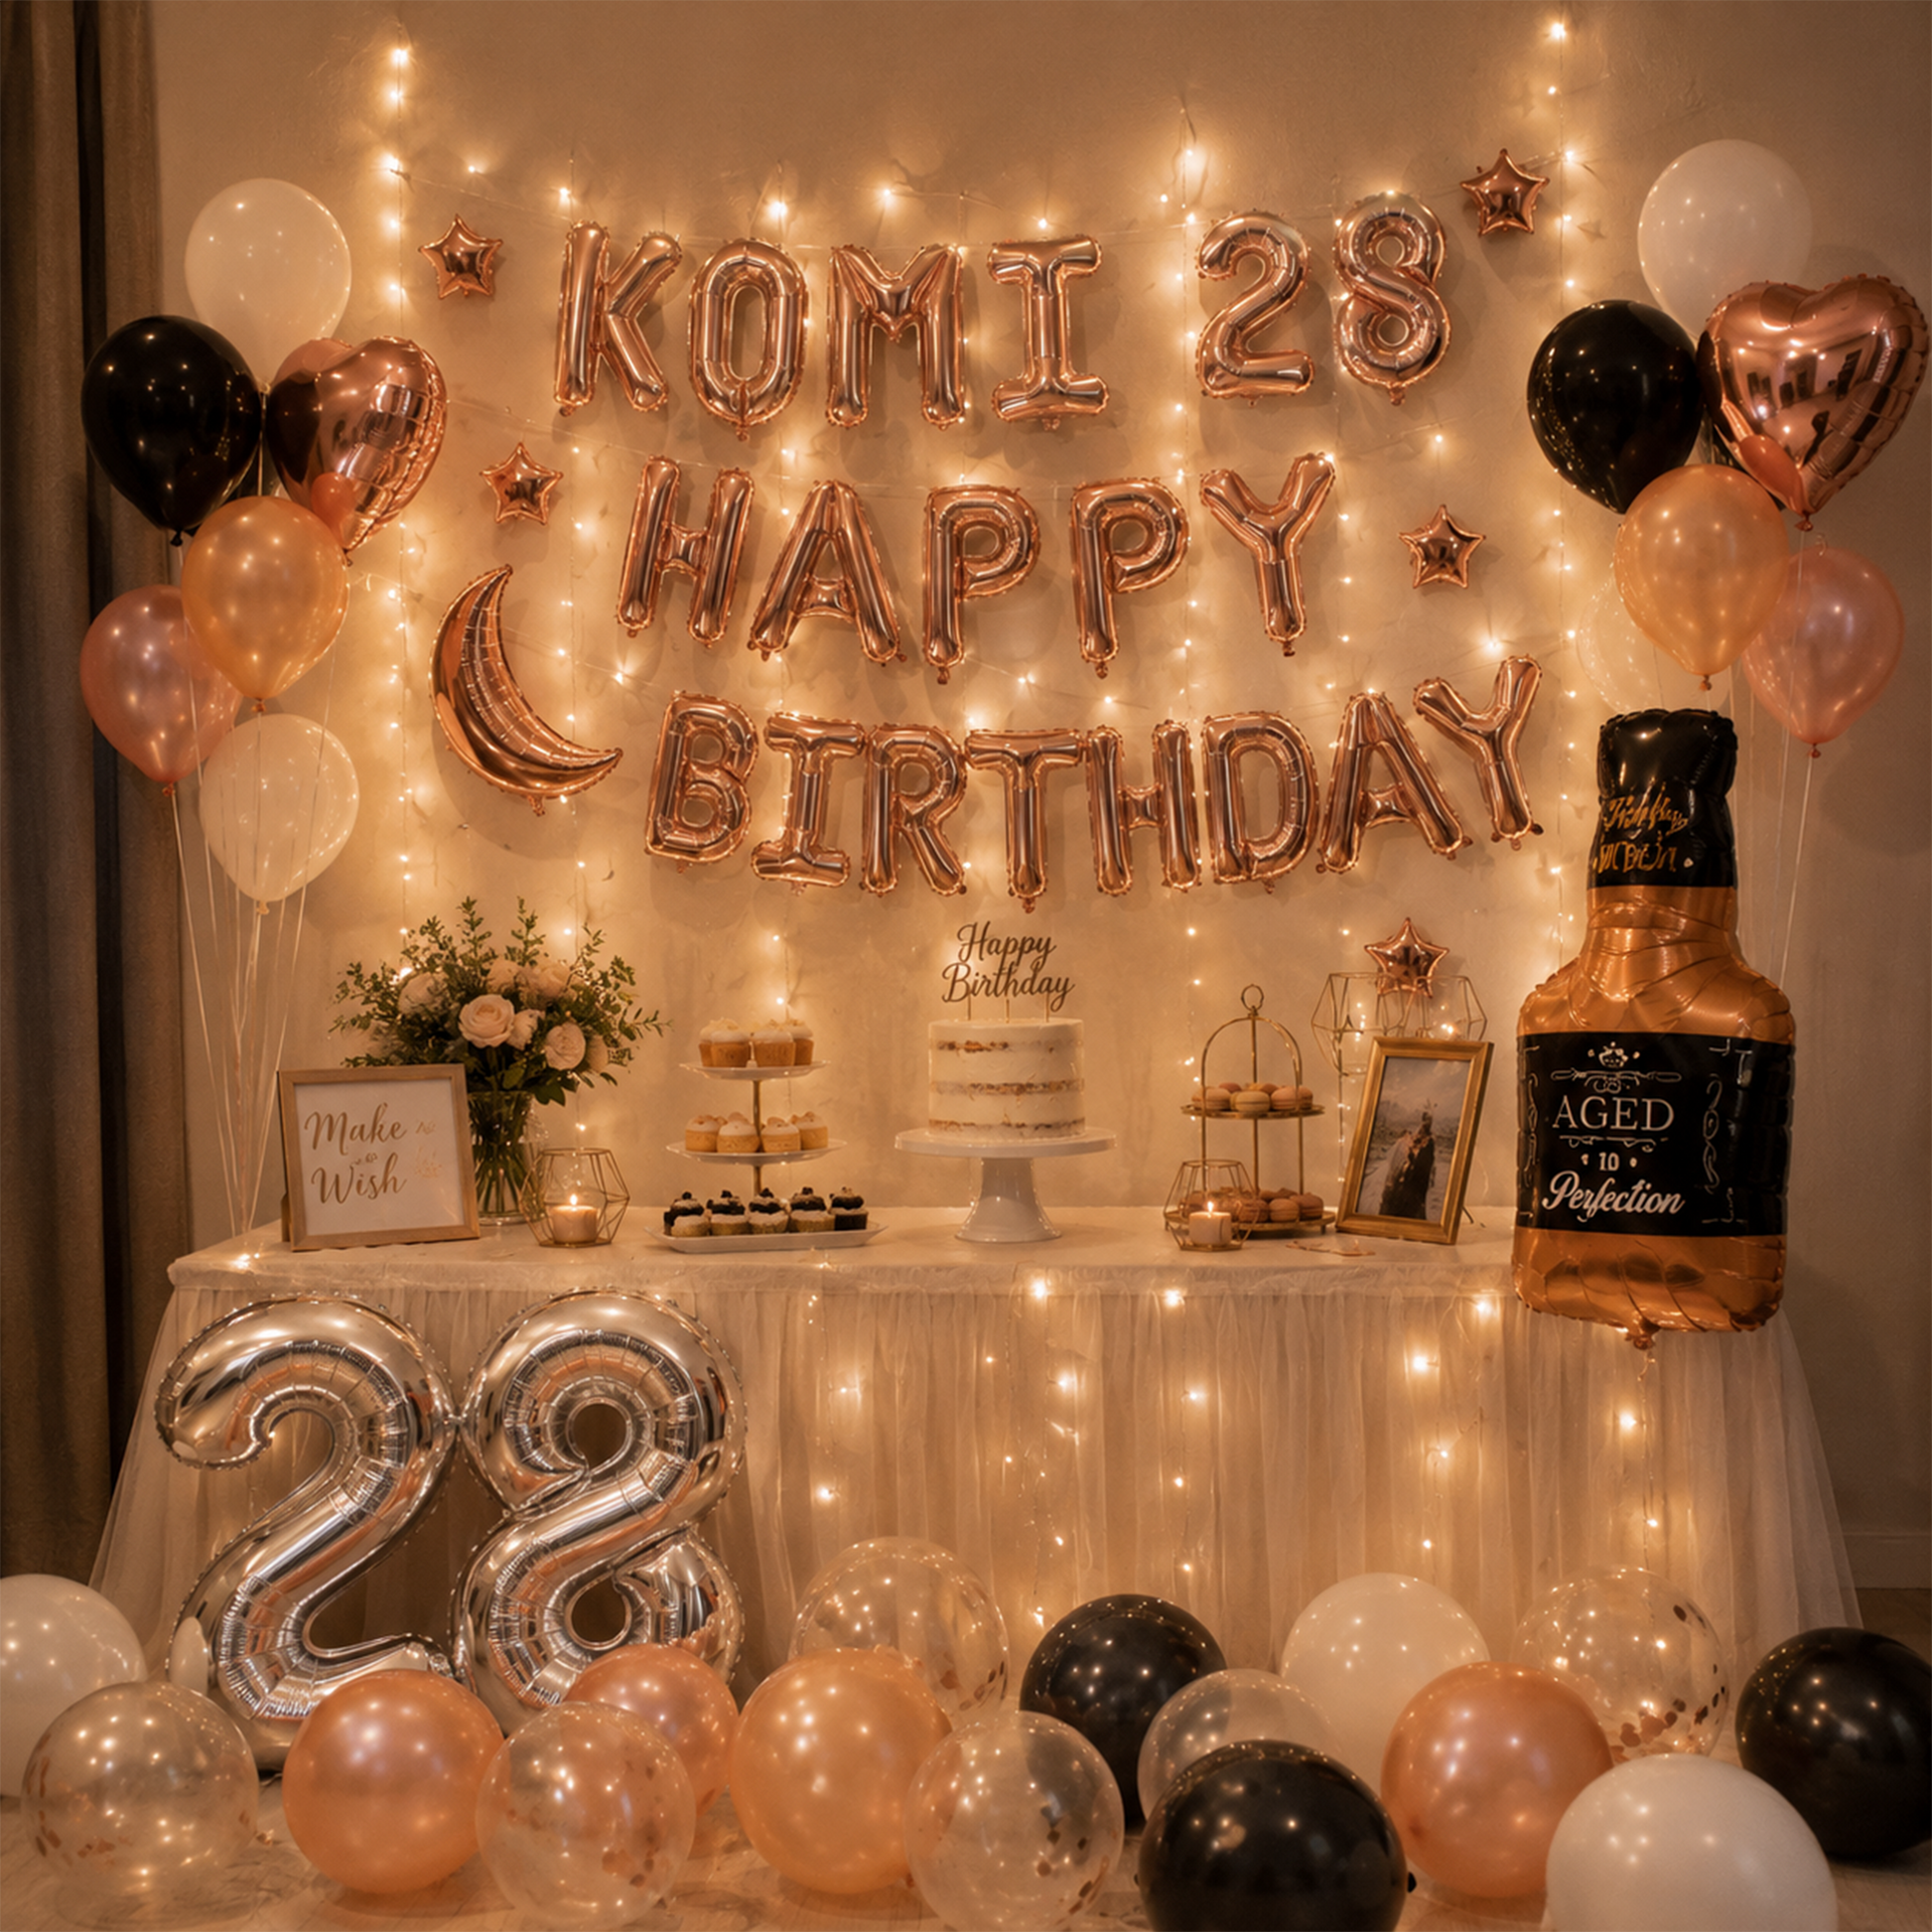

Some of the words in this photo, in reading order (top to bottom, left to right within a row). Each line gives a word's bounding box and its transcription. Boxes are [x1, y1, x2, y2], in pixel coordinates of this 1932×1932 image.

[554, 218, 1110, 439] KOMI
[1195, 192, 1452, 403] 28
[616, 453, 1337, 682] HAPPY
[645, 654, 1545, 911] BIRTHDAY
[956, 920, 1057, 974] Happy
[941, 961, 1075, 1013] Birthday
[304, 1102, 407, 1156] Make
[1552, 1094, 1675, 1131] AGED
[311, 1152, 407, 1204] Wish
[1541, 1170, 1686, 1222] Perfection
[154, 1287, 748, 1766] 28
